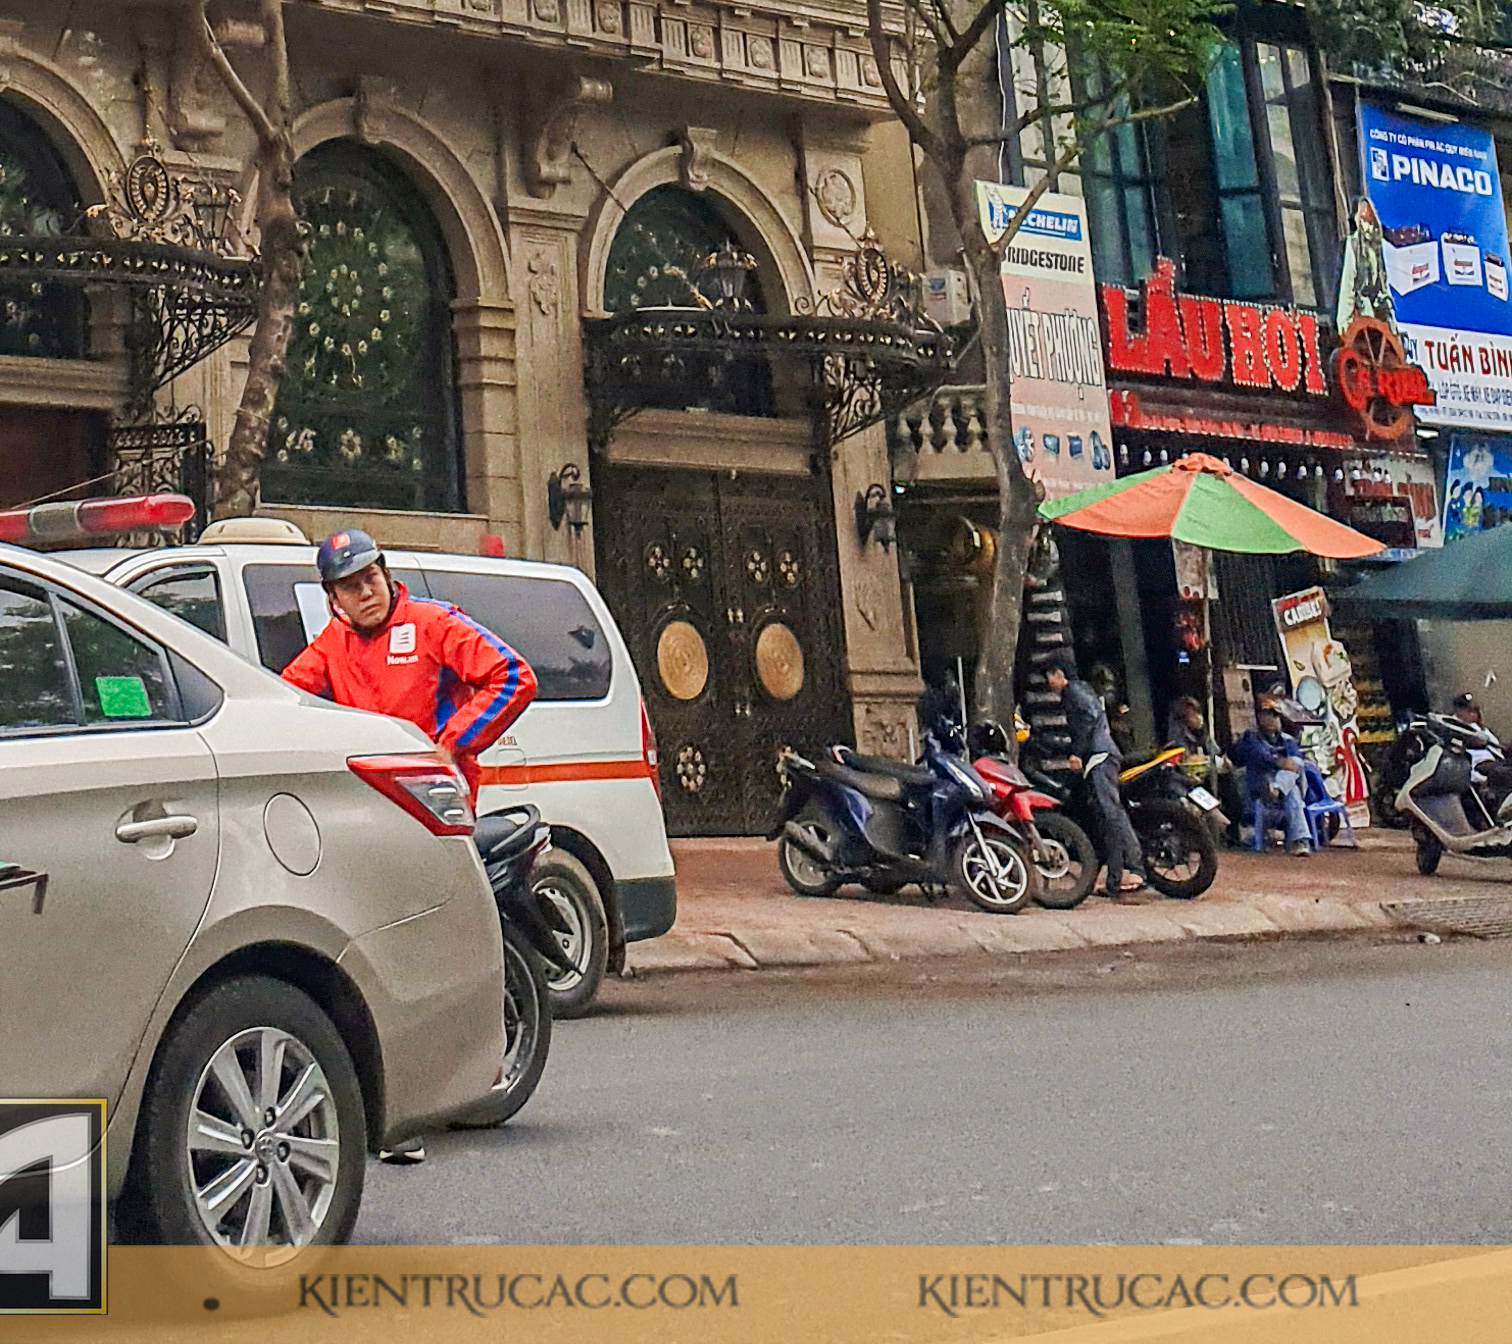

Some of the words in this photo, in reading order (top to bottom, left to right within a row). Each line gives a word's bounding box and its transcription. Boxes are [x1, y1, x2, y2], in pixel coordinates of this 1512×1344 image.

[1392, 153, 1493, 196] PINACO
[1009, 208, 1079, 234] CHELIN
[1005, 246, 1085, 274] RIDGESTONE
[1007, 286, 1045, 384] UYẾT
[1424, 333, 1475, 375] TUẤN
